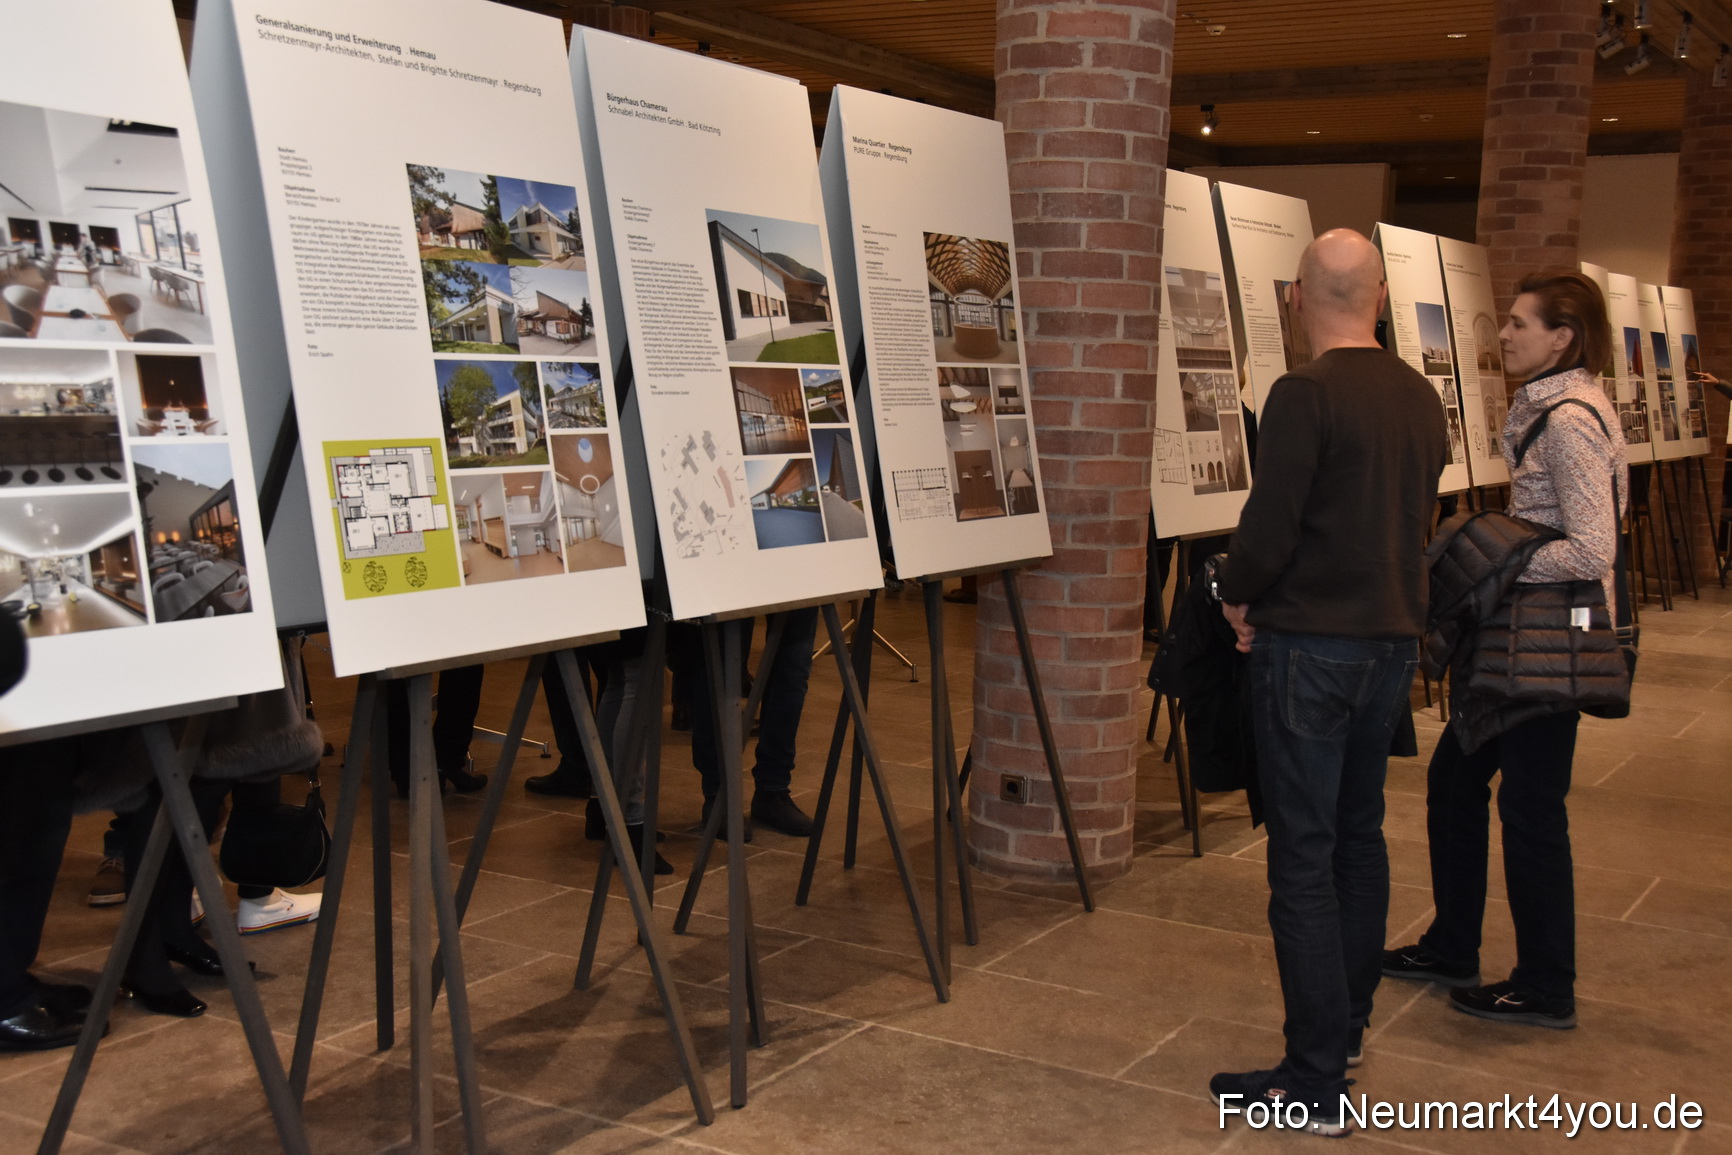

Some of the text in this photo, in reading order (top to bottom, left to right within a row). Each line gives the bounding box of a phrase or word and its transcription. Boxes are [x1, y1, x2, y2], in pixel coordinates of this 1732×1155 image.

[256, 15, 436, 60] Generalsanierung und Erweiterung Hemau
[378, 54, 403, 66] Stefan
[404, 62, 419, 70] und
[420, 63, 448, 76] Brigitte
[449, 68, 498, 88] Schretzenmayr
[504, 79, 542, 97] Regensburg
[606, 93, 668, 112] Bürgerhaus Chamerau
[608, 105, 634, 117] Schnabel
[635, 110, 667, 123] Architekten
[668, 117, 684, 127] GmbH
[688, 121, 698, 130] Bad
[853, 136, 912, 155] Marina Quartier Regensburg
[854, 146, 908, 164] PURE Gruppe Regensburg
